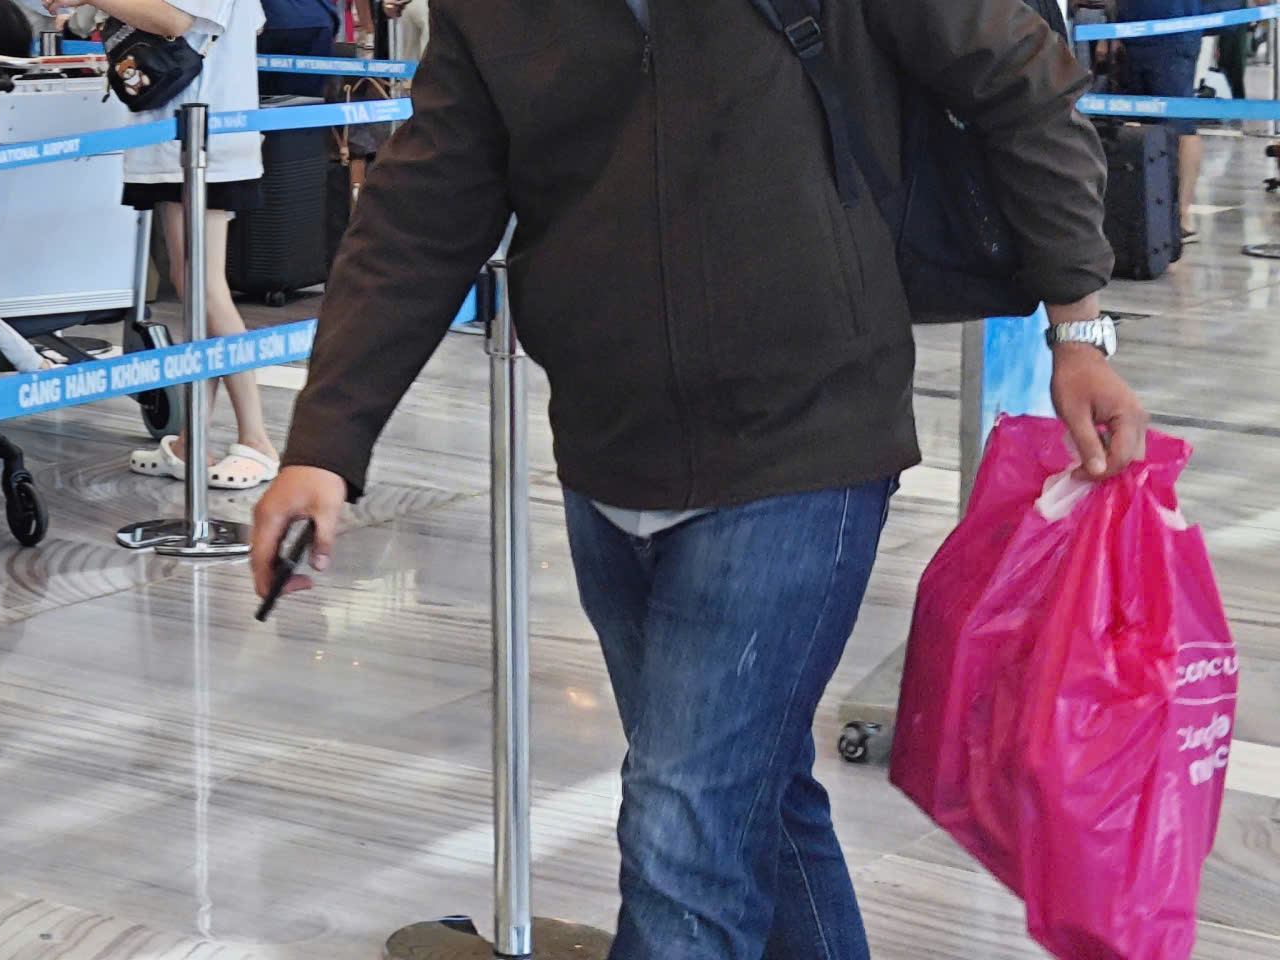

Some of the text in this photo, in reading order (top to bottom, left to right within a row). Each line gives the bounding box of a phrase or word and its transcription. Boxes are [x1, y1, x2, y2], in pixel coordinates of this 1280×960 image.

[341, 104, 369, 123] TIA
[42, 138, 81, 156] AIRPORT
[19, 374, 62, 409] CẢNG
[65, 367, 107, 399] HÀNG
[110, 357, 161, 390] KHÔNG
[163, 343, 202, 380] QUỐC
[206, 337, 225, 371] TẾ
[228, 337, 256, 366] TÂN
